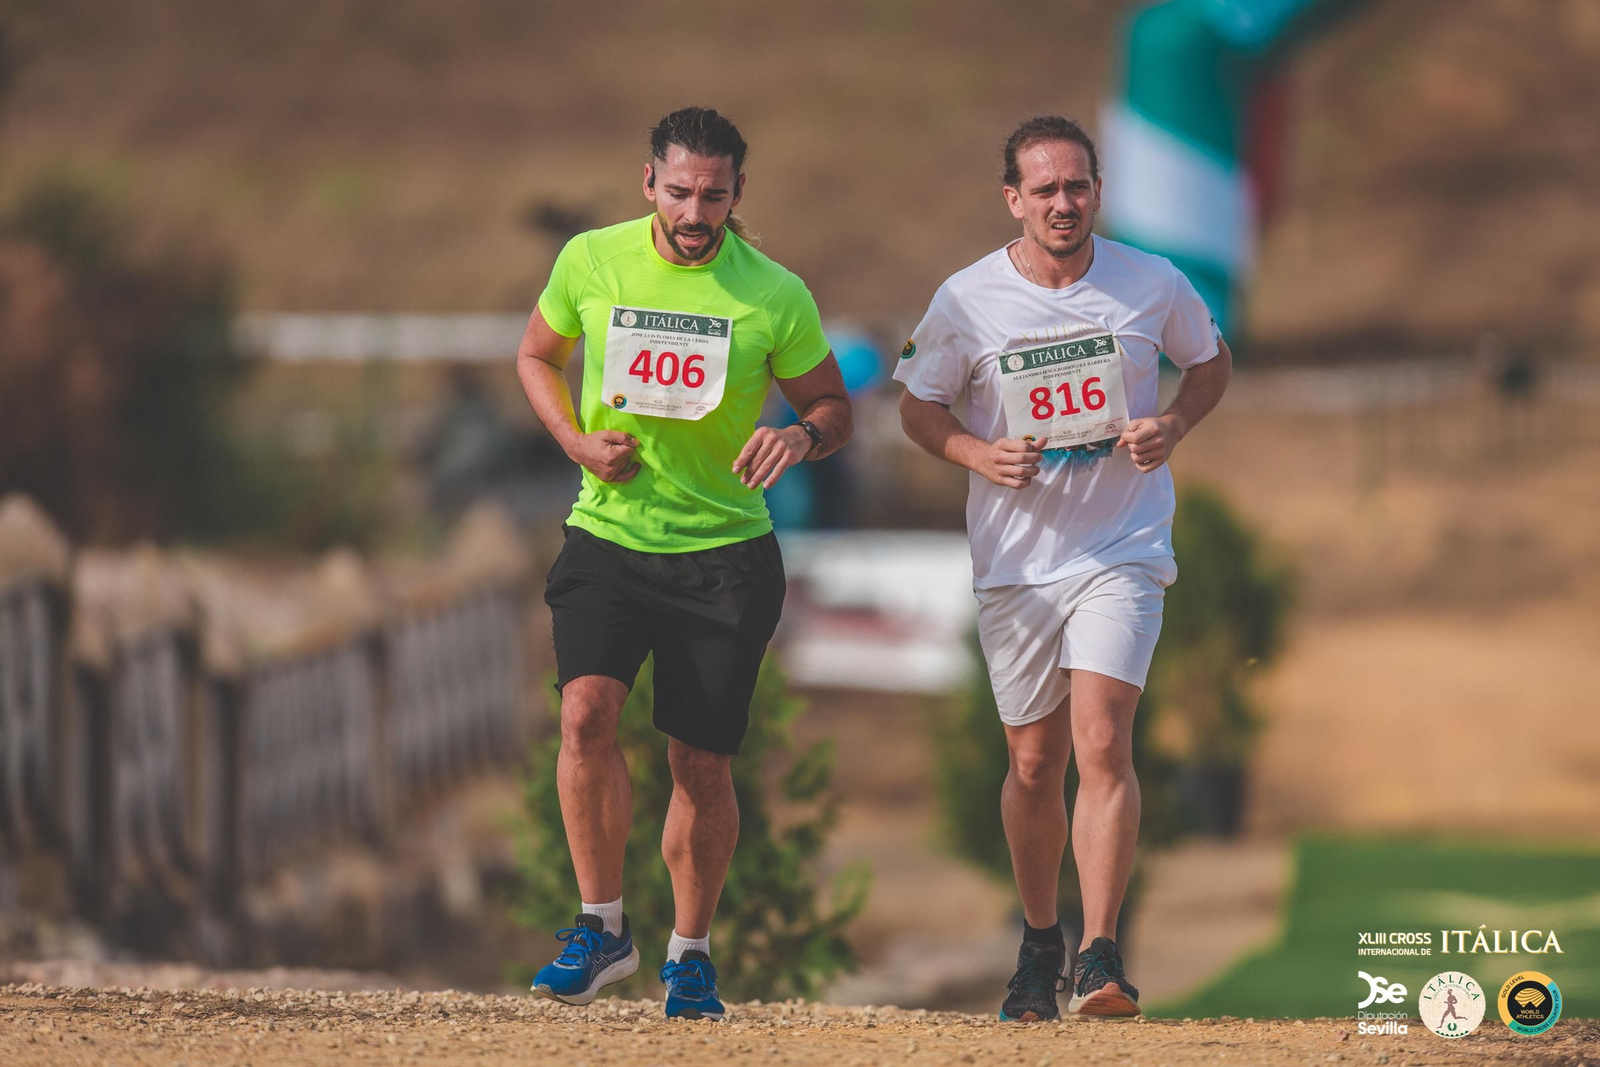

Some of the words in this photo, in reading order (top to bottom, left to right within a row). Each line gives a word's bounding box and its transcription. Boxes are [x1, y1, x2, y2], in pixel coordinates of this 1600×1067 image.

[644, 314, 700, 331] ITÁLICA
[1030, 344, 1086, 364] ITÁLICA
[628, 350, 705, 388] 406
[1013, 372, 1042, 380] ALEJANDRO
[1042, 369, 1081, 380] INDEPENDIENTE
[1029, 377, 1106, 420] 816
